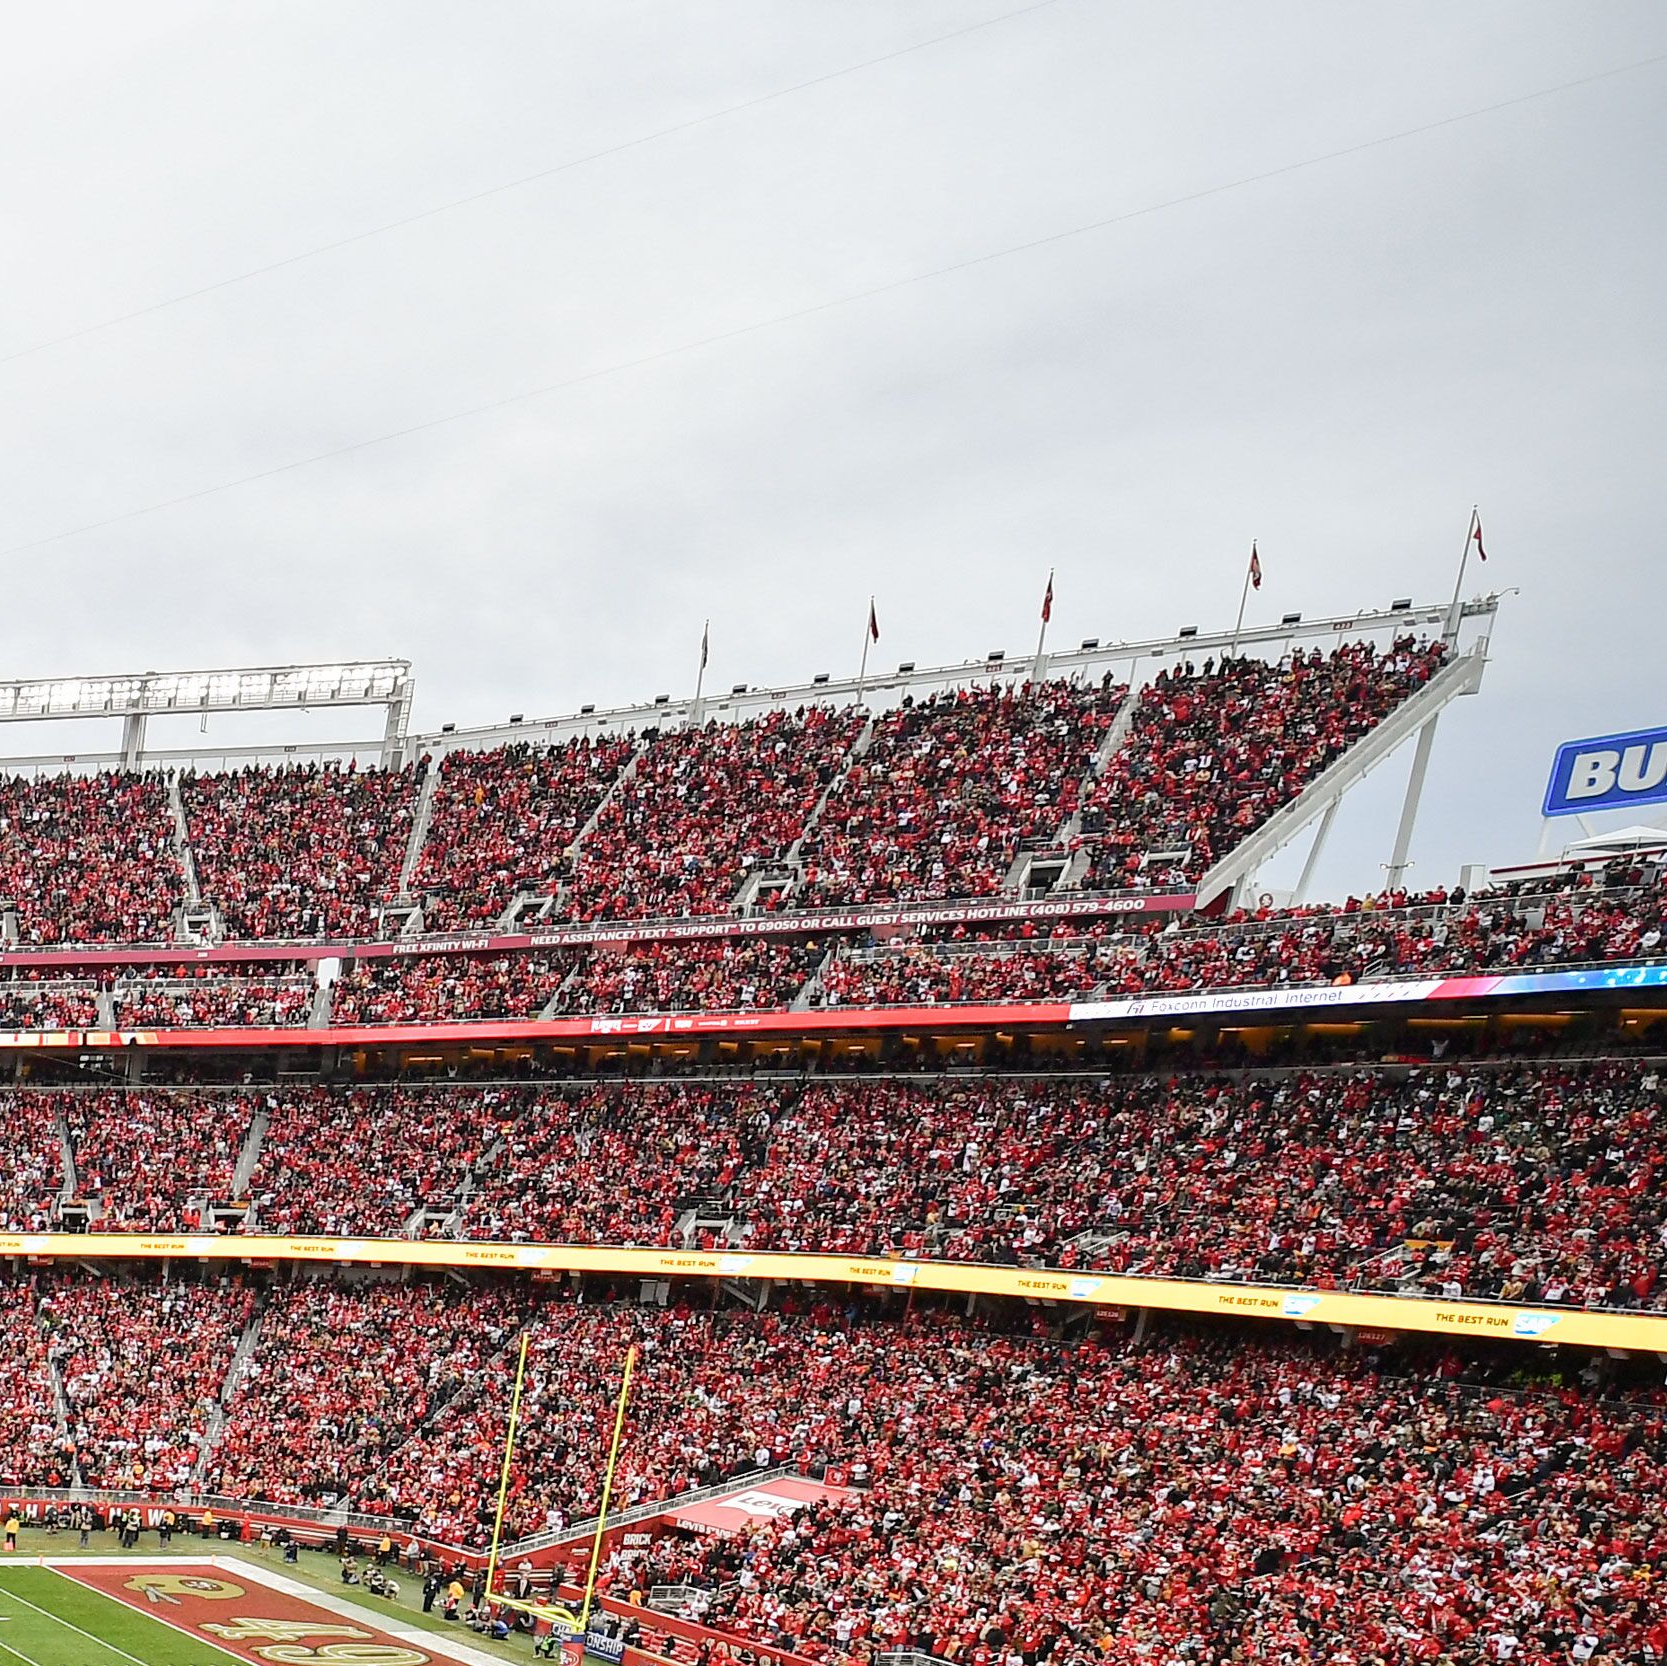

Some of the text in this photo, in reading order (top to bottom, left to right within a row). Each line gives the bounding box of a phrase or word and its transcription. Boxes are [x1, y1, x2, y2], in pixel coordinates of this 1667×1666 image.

[531, 935, 560, 946] NEED
[562, 929, 636, 944] ASSISTANCE?
[638, 928, 667, 940] TEXT
[740, 922, 755, 933] TO
[757, 919, 799, 932] 69050
[801, 919, 820, 930] OR
[822, 917, 854, 929] CALL
[857, 913, 900, 927] GUEST
[901, 910, 964, 924] SERVICES
[966, 906, 1028, 919] HOTLINE
[1030, 902, 1070, 916] (408)
[1071, 899, 1145, 914] 579-4600
[393, 939, 488, 954] FREE XFINITY WI-FI
[1151, 999, 1206, 1014] Foxconn
[1212, 994, 1277, 1009] Industrial
[1285, 990, 1343, 1004] Internet
[1032, 1281, 1049, 1289] BEST
[1219, 1295, 1278, 1307] THE BEST RUN
[1435, 1312, 1455, 1323] THE
[1457, 1314, 1483, 1325] BEST
[1486, 1317, 1509, 1328] RUN
[623, 1534, 652, 1545] BRICK
